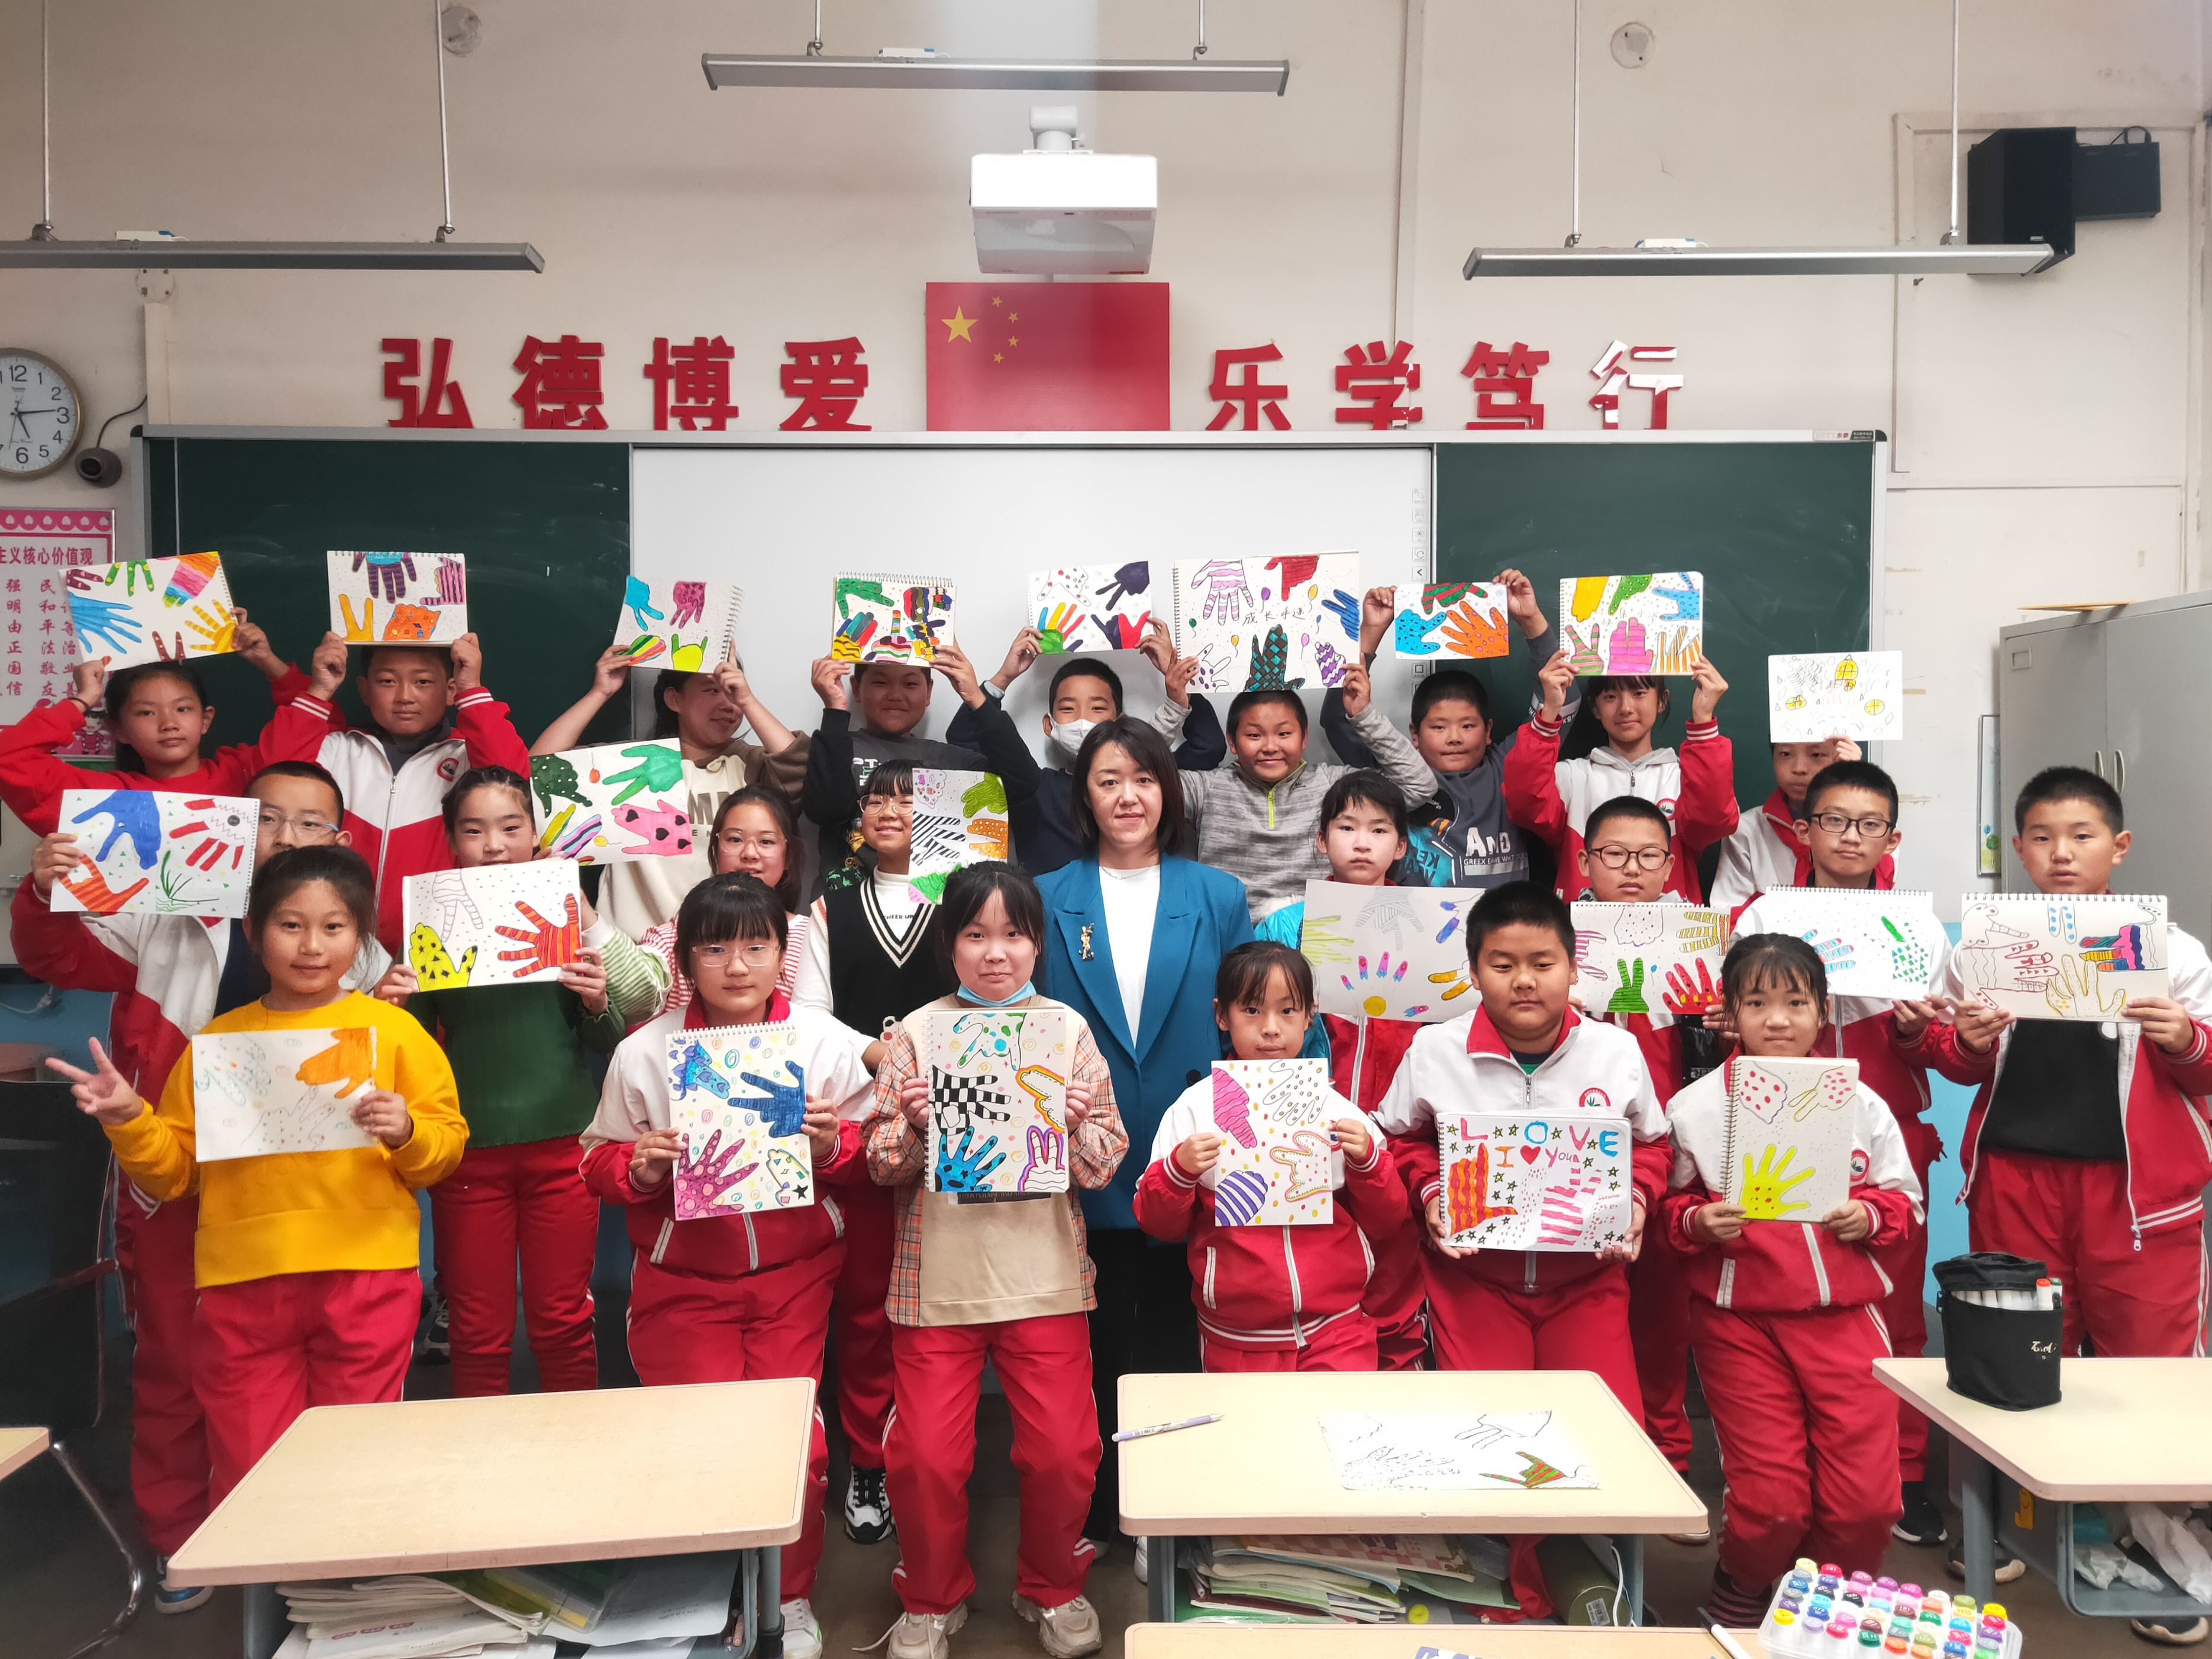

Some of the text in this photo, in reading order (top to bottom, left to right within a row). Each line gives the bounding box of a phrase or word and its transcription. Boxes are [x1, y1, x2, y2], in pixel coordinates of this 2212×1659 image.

[9, 365, 27, 382] 12
[37, 372, 43, 385] 1
[382, 335, 1684, 431] 弘德博爱 乐学笃行
[51, 386, 62, 401] 2
[56, 407, 70, 424] 3
[53, 430, 63, 444] 4
[15, 447, 28, 463] 6
[39, 444, 49, 457] 5
[1461, 1117, 1619, 1157] LOVE
[1494, 1146, 1516, 1168] I
